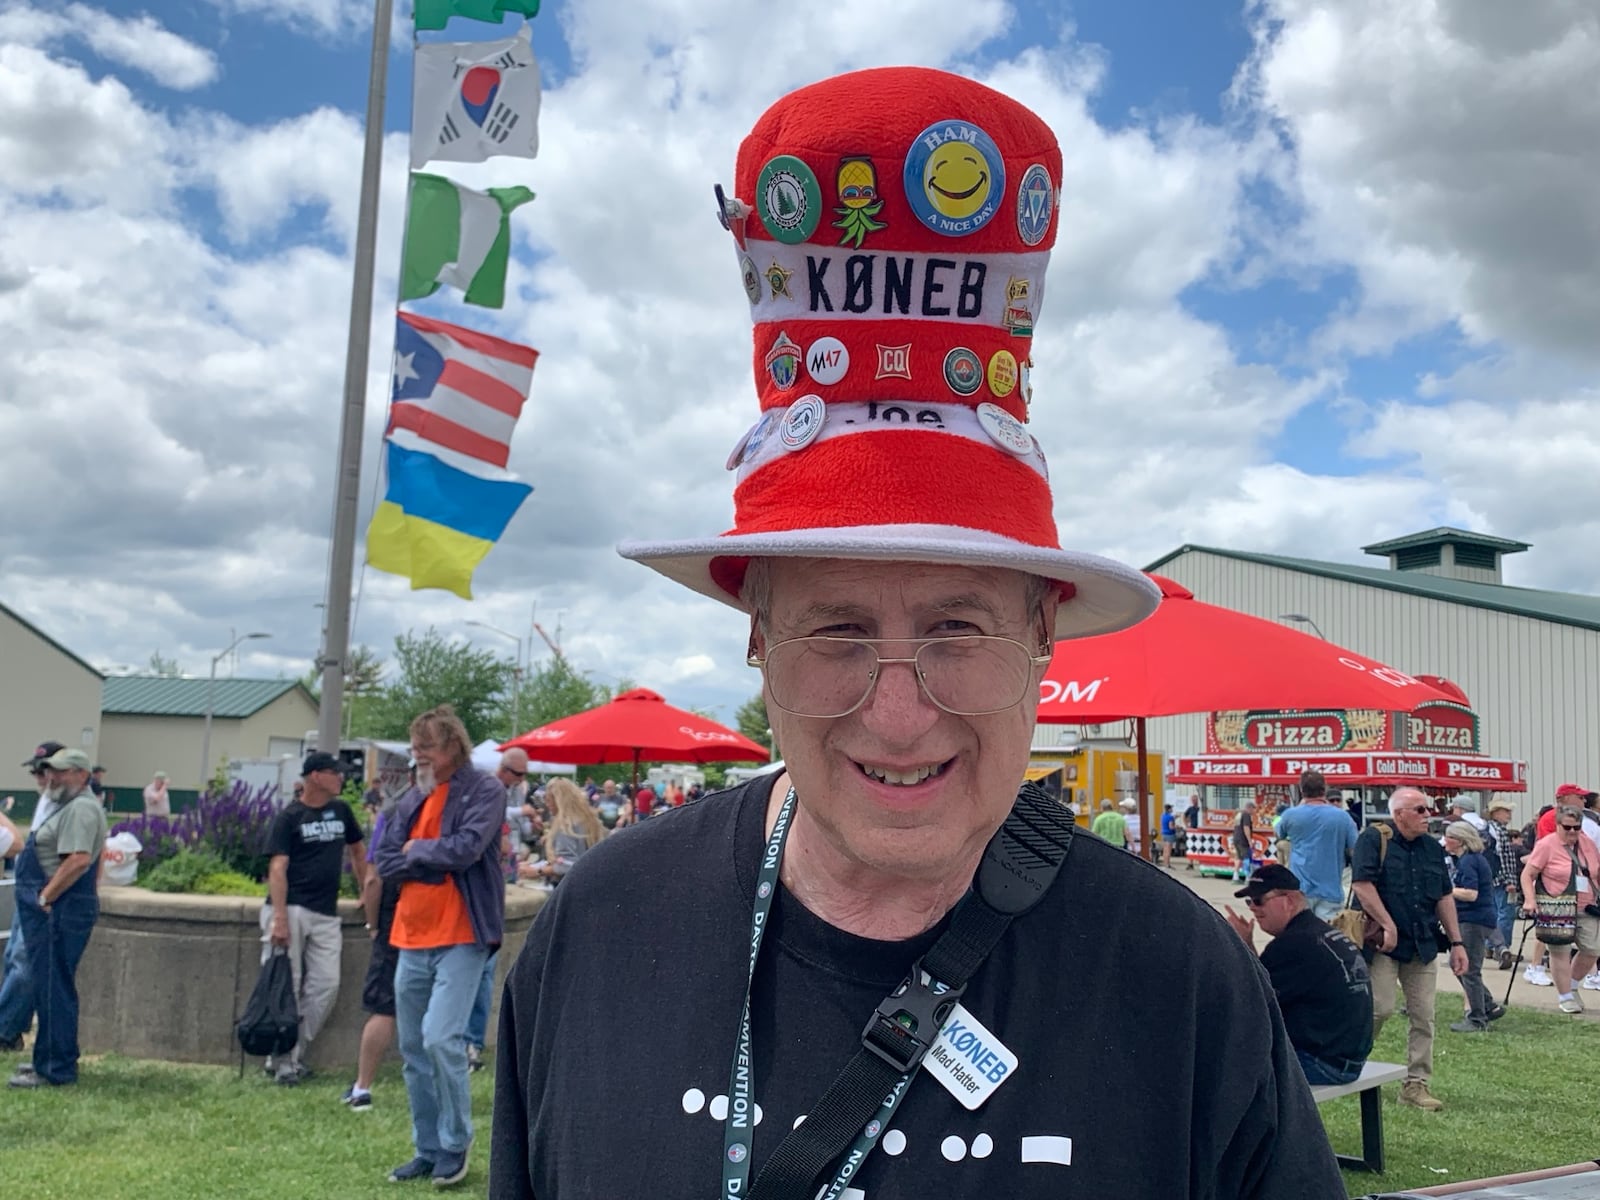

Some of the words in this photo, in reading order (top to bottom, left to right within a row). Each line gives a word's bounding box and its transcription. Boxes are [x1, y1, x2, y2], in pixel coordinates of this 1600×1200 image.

[923, 126, 978, 151] HAM
[927, 213, 937, 224] A
[940, 219, 971, 232] NICE
[973, 202, 995, 227] DAY
[811, 350, 842, 374] M17
[883, 350, 906, 372] CQ
[1257, 722, 1334, 746] Pizza
[1410, 718, 1473, 748] Pizza
[1192, 761, 1249, 774] Pizza
[1376, 759, 1395, 774] Cold
[1398, 760, 1427, 775] Drinks
[1448, 762, 1501, 778] Pizza
[931, 1045, 957, 1069] Mad
[950, 1062, 980, 1094] Hatter
